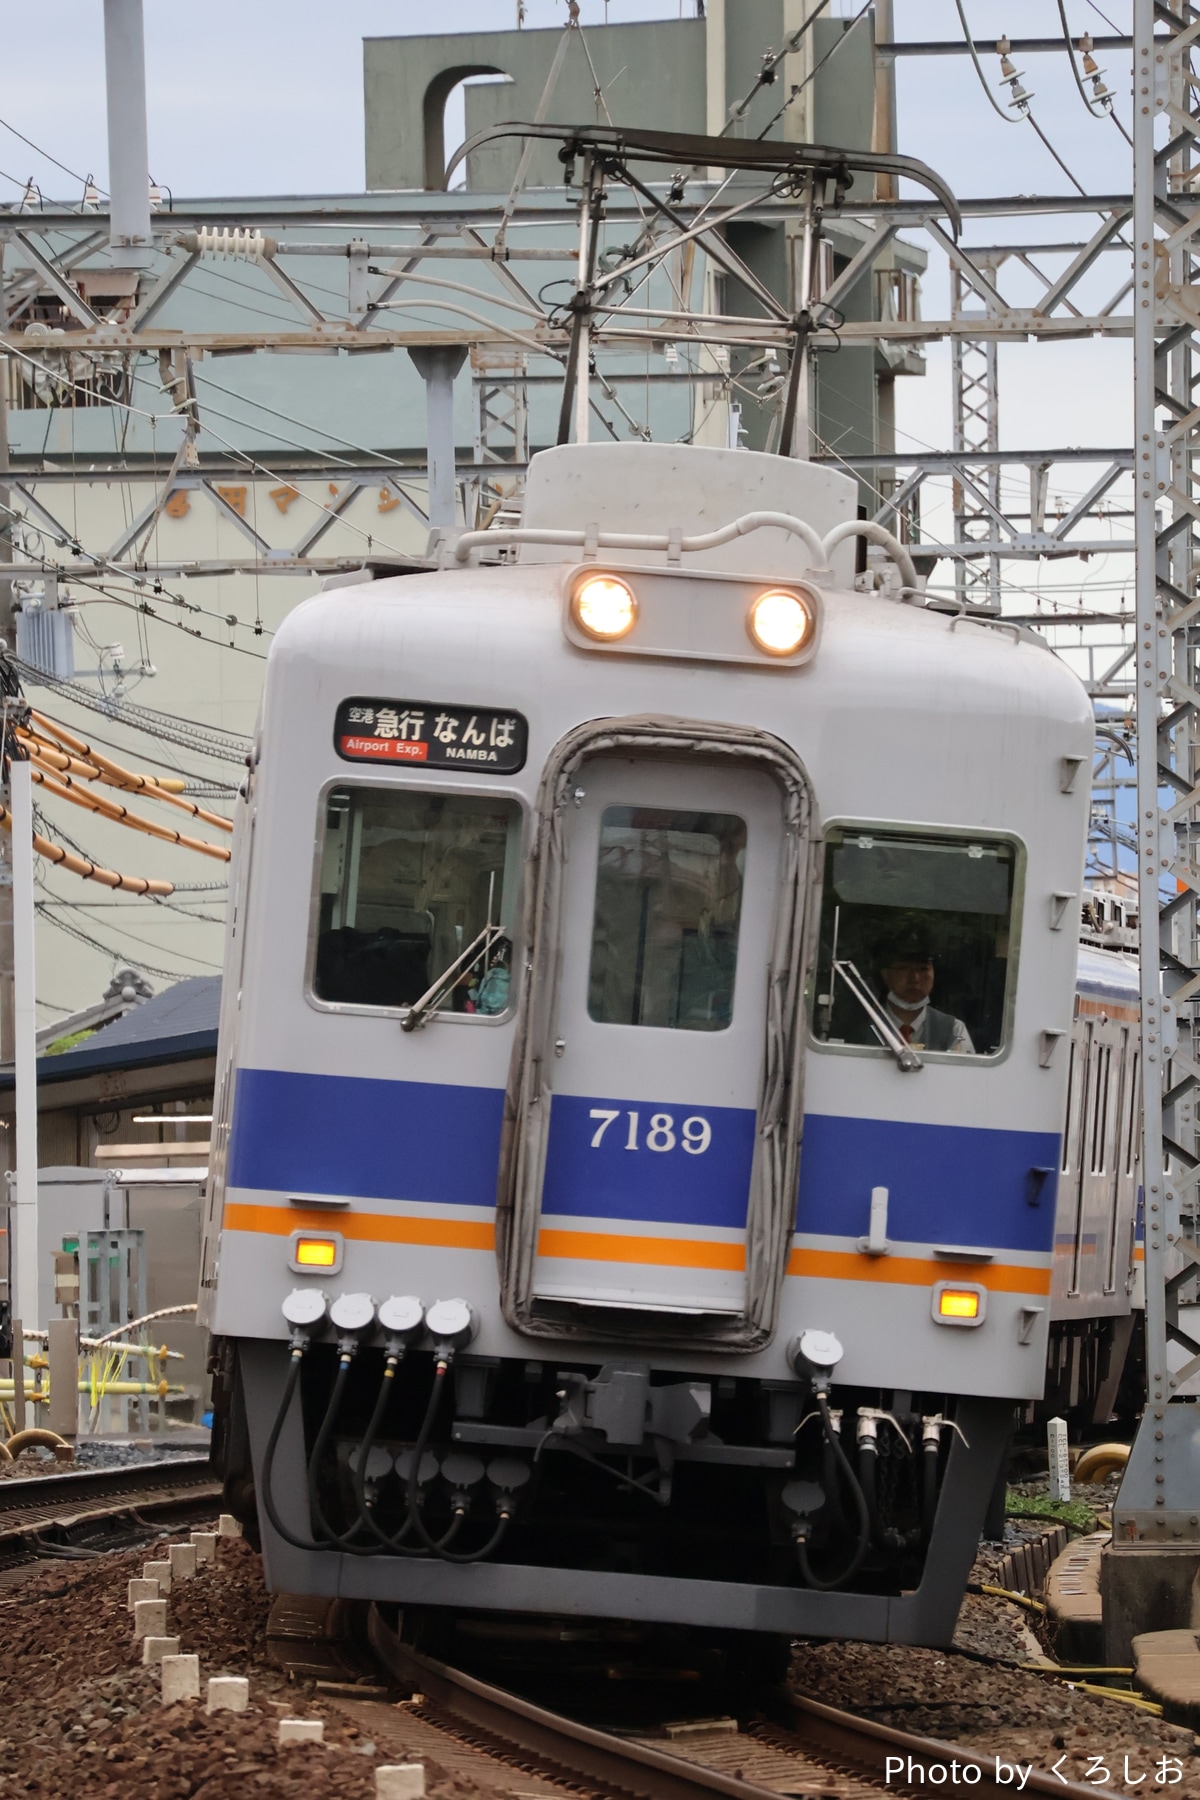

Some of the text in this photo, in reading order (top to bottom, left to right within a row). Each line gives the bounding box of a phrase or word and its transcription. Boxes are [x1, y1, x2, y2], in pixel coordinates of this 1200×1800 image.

[348, 706, 517, 748] 空港急行 なんば
[346, 739, 423, 756] Airport Exp.
[446, 747, 498, 762] NAMBA
[589, 1108, 712, 1155] 7189
